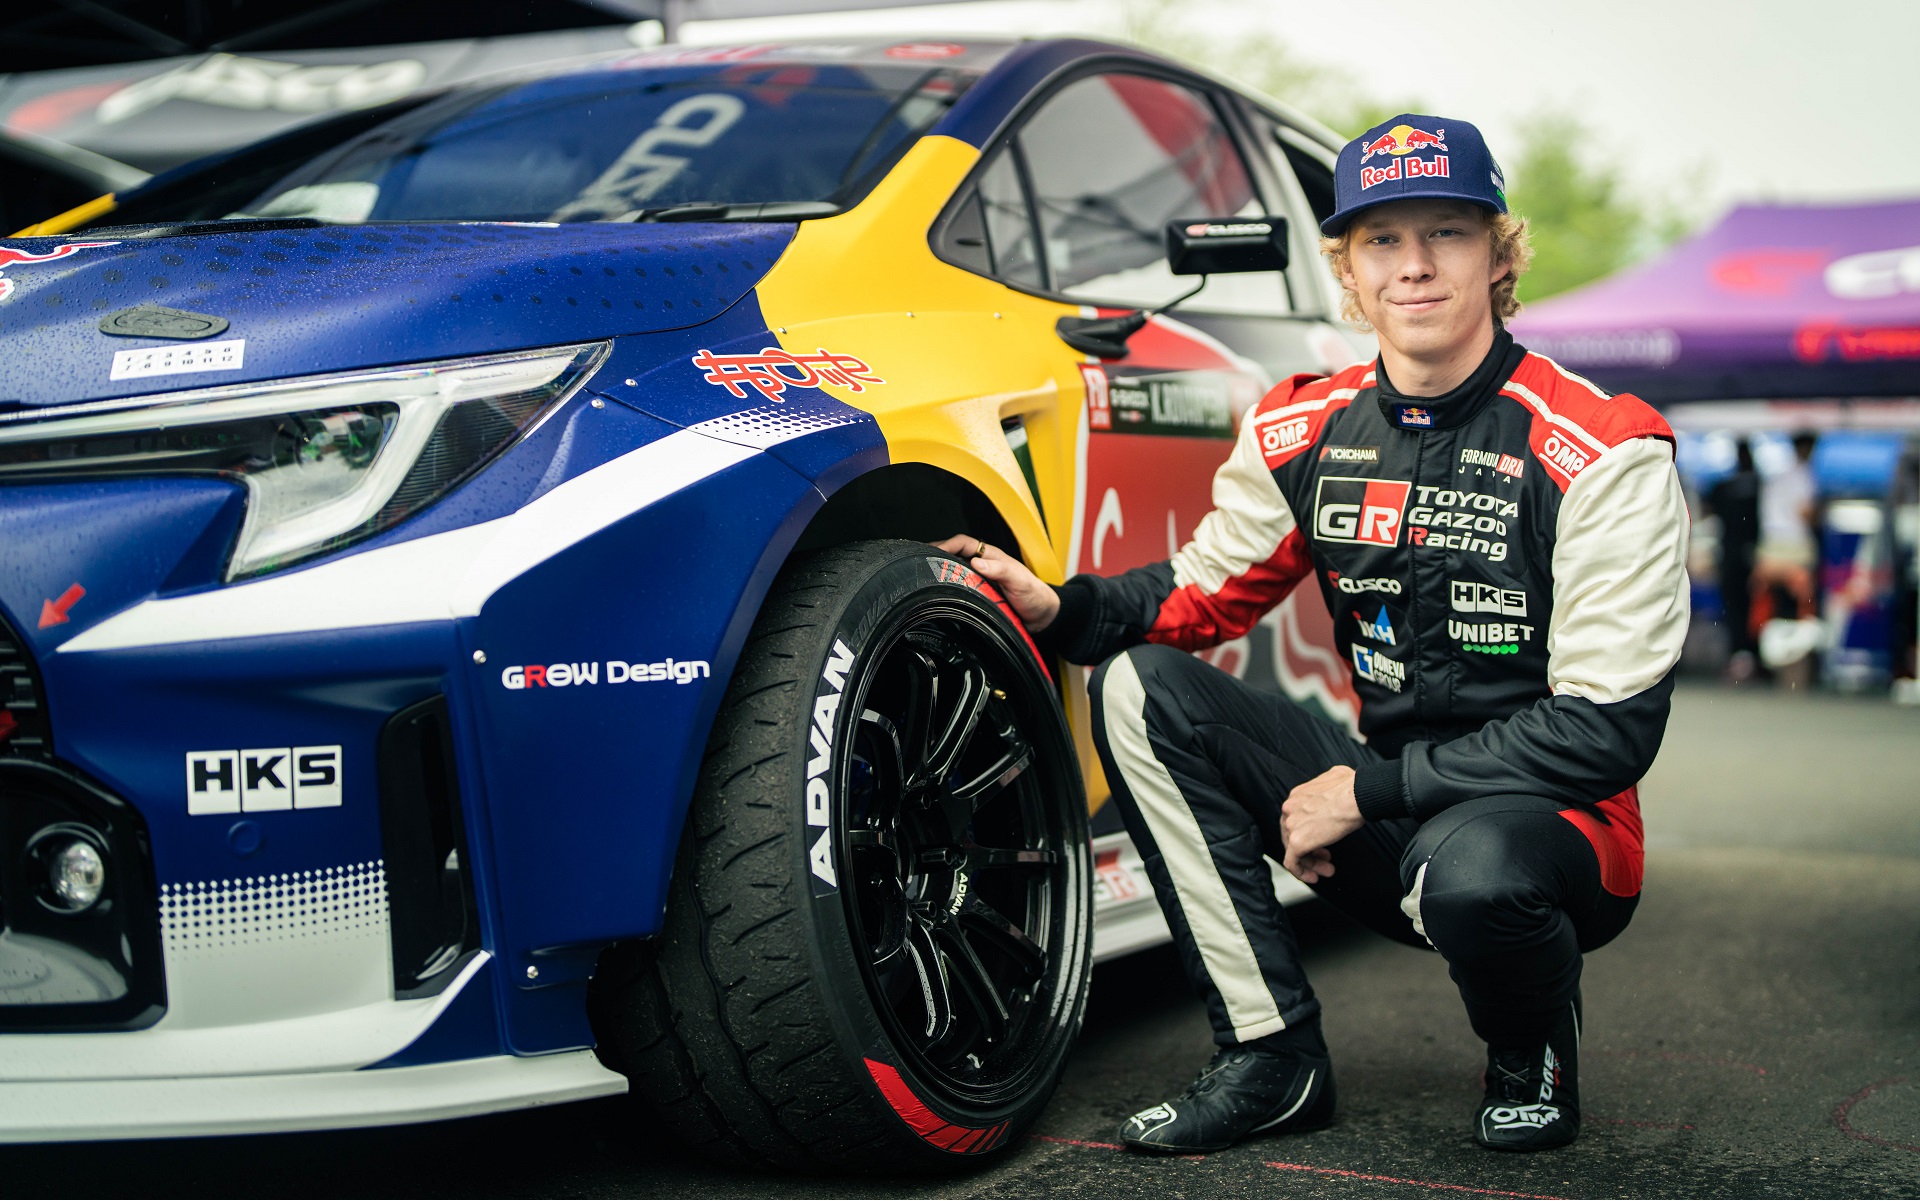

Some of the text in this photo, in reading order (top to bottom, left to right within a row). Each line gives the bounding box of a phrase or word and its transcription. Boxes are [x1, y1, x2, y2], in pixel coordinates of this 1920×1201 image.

[1361, 155, 1449, 190] Red Bull
[1263, 421, 1308, 450] OMP
[1330, 448, 1377, 460] YOKOHAMA
[1544, 436, 1586, 474] OMP
[1415, 485, 1519, 518] TOYOTA
[1318, 503, 1400, 542] GR
[1407, 506, 1507, 537] GAZOO
[1407, 526, 1508, 562] Racing
[1338, 577, 1402, 595] CUSCO
[1452, 581, 1525, 611] HKS
[1448, 619, 1535, 643] UNIBET
[502, 657, 710, 690] GROW Design
[192, 751, 337, 797] HKS
[806, 638, 856, 888] ADVAN
[949, 872, 969, 916] ADVAN
